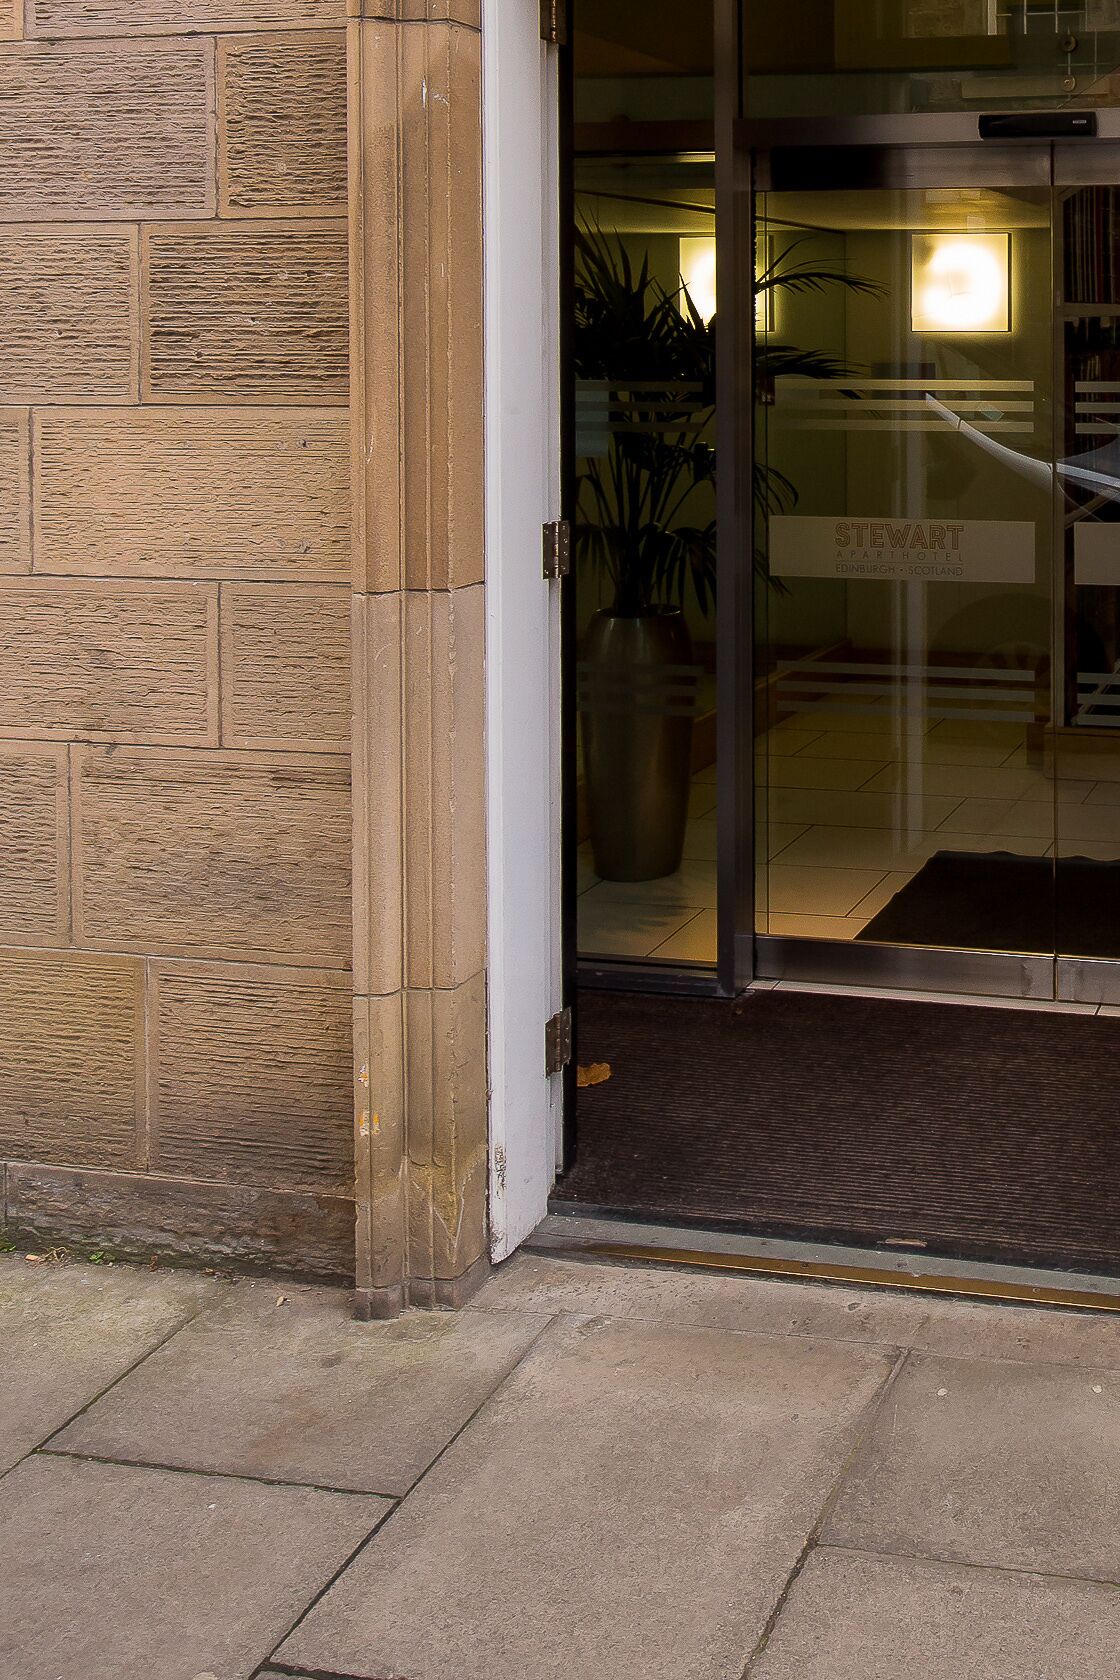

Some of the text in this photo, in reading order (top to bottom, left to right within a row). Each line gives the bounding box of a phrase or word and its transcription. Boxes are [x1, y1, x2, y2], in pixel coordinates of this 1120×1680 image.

[834, 522, 965, 551] STEWART
[836, 550, 964, 562] APARTHOTEL
[835, 563, 964, 577] EDINBURGH SCOTLAND
